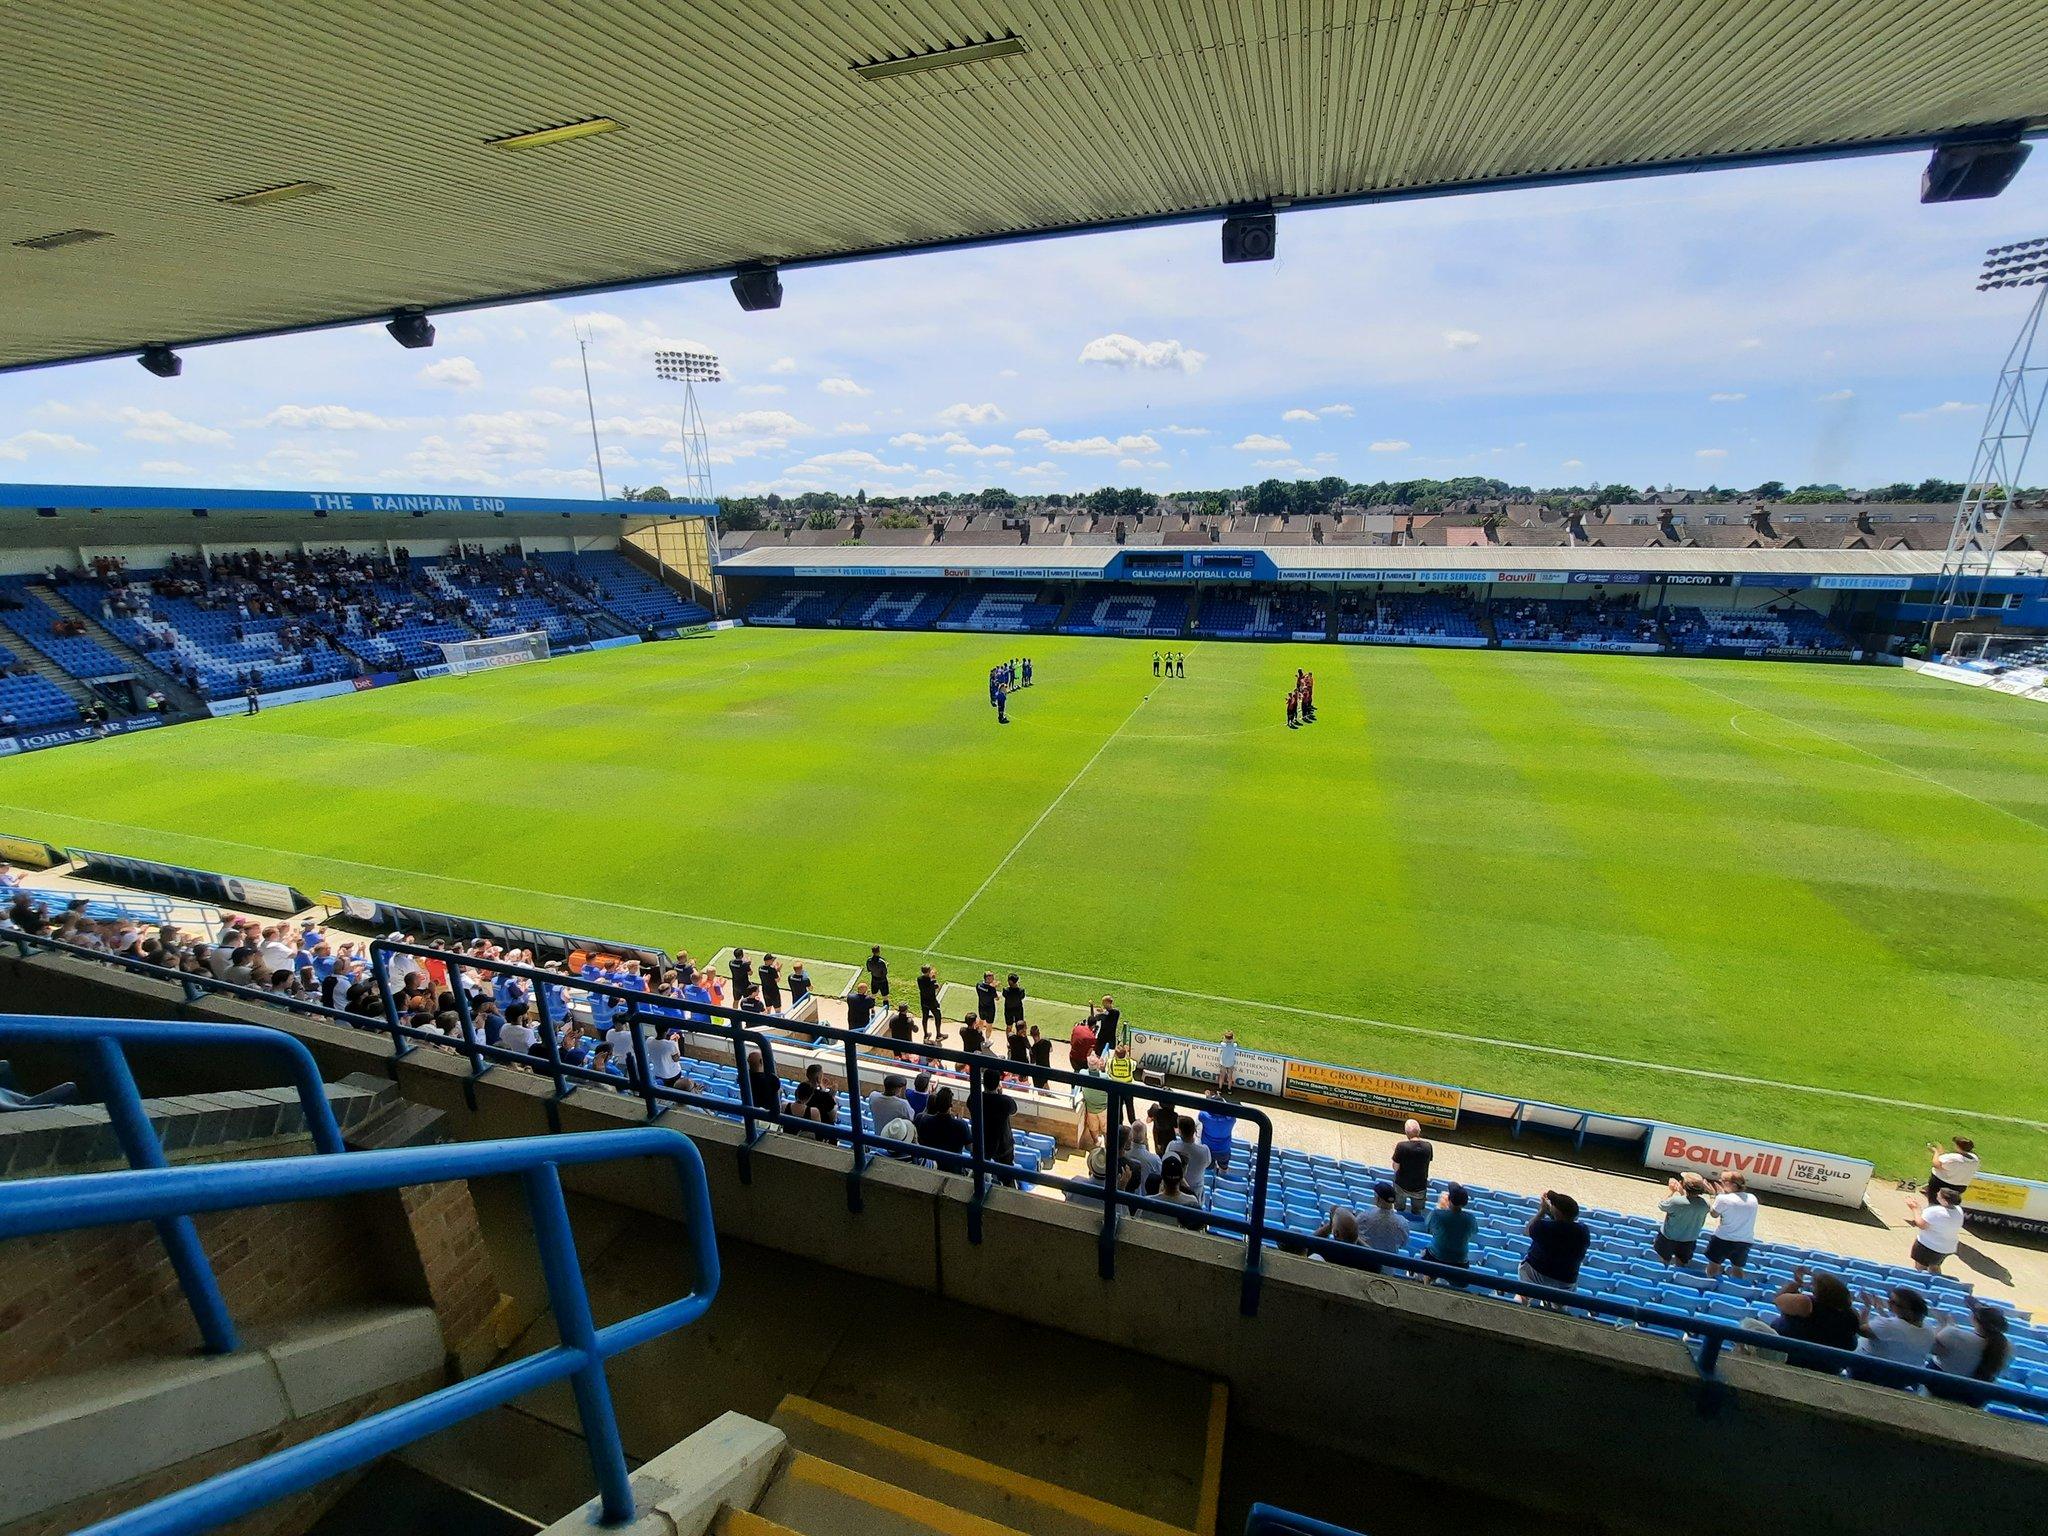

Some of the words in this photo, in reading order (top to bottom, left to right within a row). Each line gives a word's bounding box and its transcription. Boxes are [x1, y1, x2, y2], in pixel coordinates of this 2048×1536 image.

[310, 494, 353, 510] THE
[372, 495, 462, 511] RAINHAM
[472, 498, 505, 511] END
[862, 568, 886, 576] SERVICES
[944, 568, 970, 577] Bauvill
[1132, 570, 1180, 578] GILLINGHAM
[1182, 570, 1225, 578] FOOTBALL
[1229, 571, 1252, 579] CLUB
[1420, 572, 1430, 580] PG
[1432, 572, 1446, 580] SITE
[1447, 573, 1486, 581] SERVICES
[1498, 572, 1535, 582] Bauvill
[1667, 574, 1712, 584] macron
[1824, 578, 1837, 587] PG
[1838, 579, 1858, 587] SITE
[1860, 579, 1906, 588] SERVICES
[1590, 642, 1631, 650] TeleCare
[1816, 649, 1851, 657] STADIUM
[127, 716, 157, 725] Funeral
[127, 721, 161, 731] Directors
[22, 731, 70, 747] JOHN
[74, 722, 122, 737] WIR
[1192, 1043, 1219, 1053] general
[1246, 1069, 1268, 1078] TILING
[1290, 1063, 1325, 1076] LITTLE
[1330, 1070, 1373, 1085] GROVES
[1376, 1078, 1421, 1093] LEISURE
[1426, 1087, 1456, 1099] PARK
[1289, 1079, 1309, 1087] Private
[1310, 1083, 1329, 1091] Beach
[1333, 1086, 1348, 1094] Club
[1348, 1089, 1368, 1098] House
[1373, 1094, 1387, 1102] New
[1393, 1098, 1410, 1106] Used
[1409, 1101, 1434, 1110] Caravan
[1434, 1105, 1453, 1113] Sales
[1323, 1090, 1339, 1098] Static
[1340, 1094, 1362, 1102] Caravan
[1363, 1097, 1391, 1108] Transport
[1391, 1103, 1415, 1112] Services
[1327, 1098, 1344, 1107] Call
[1664, 1136, 1782, 1177] Bauvill
[1794, 1171, 1828, 1183] IDEAS
[1797, 1164, 1814, 1173] WE
[1816, 1167, 1851, 1180] BUILD
